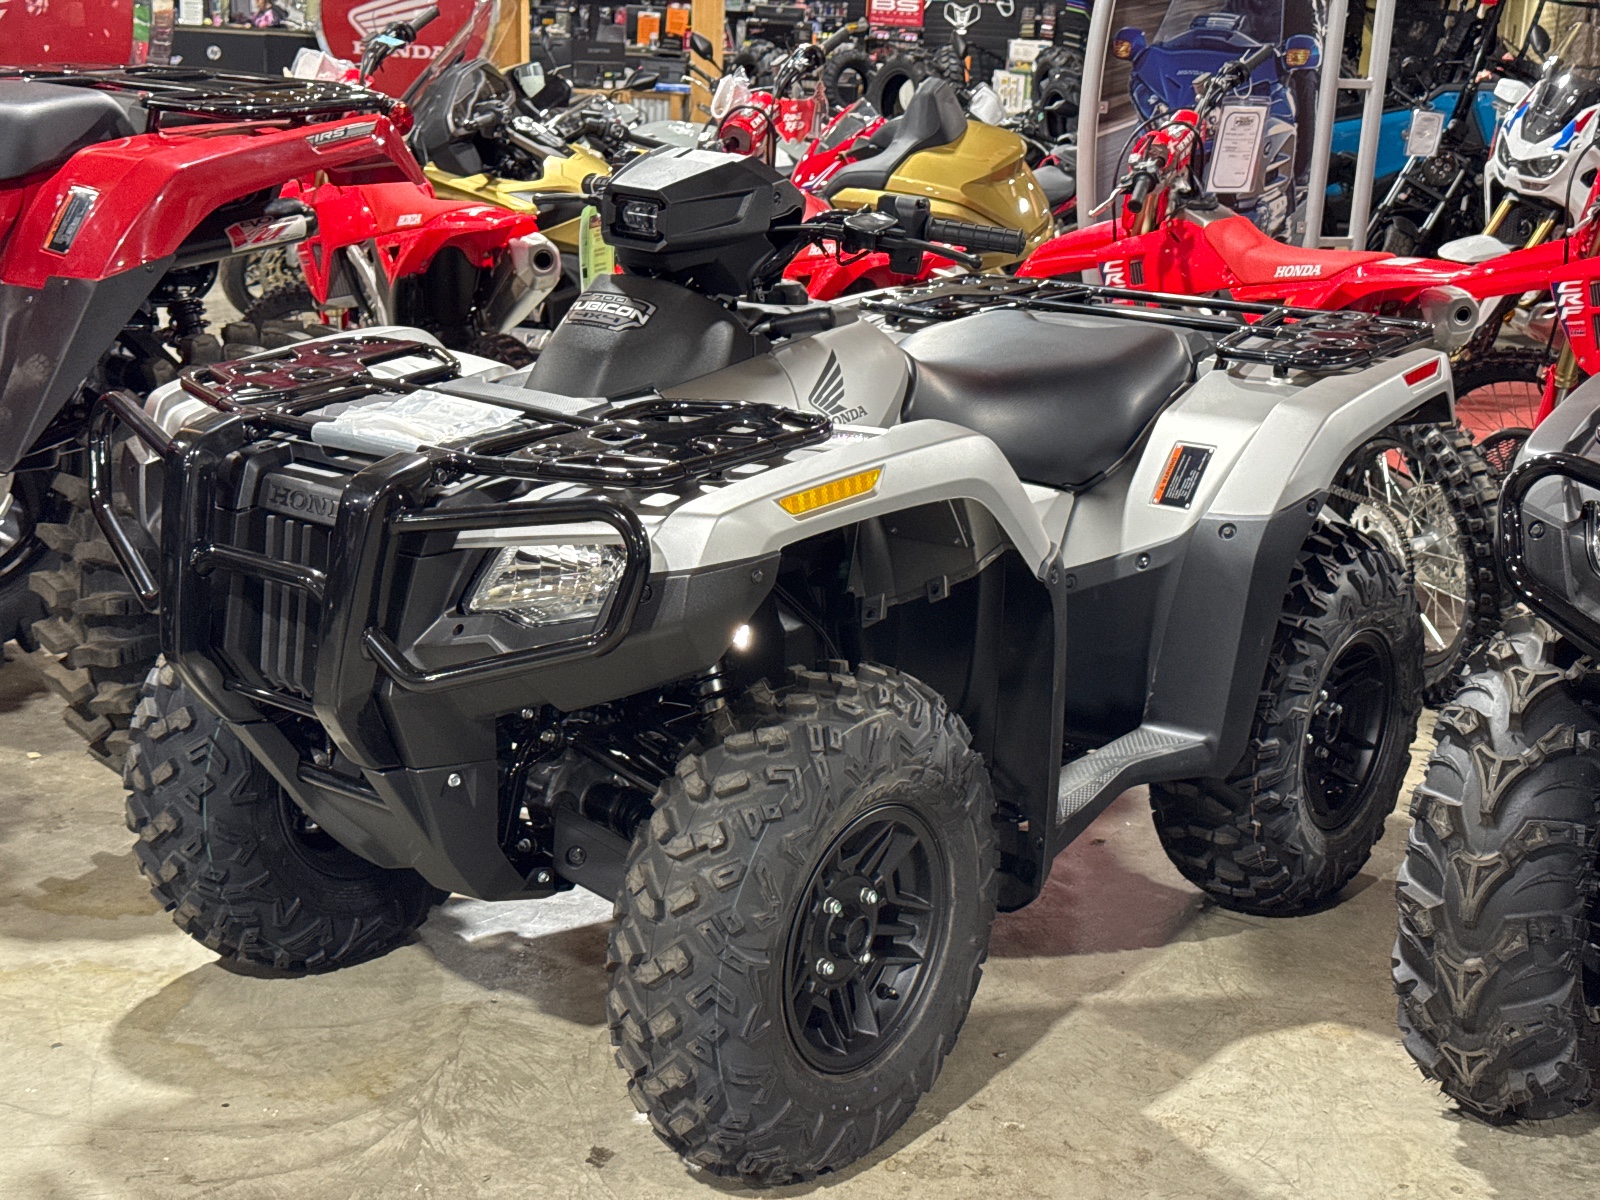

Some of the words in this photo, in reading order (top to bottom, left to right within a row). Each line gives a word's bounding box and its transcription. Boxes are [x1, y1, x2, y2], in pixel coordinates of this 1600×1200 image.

[871, 0, 920, 12] BS
[314, 126, 346, 143] IRS
[1273, 264, 1322, 279] HONDA
[592, 293, 629, 304] 700
[1556, 280, 1586, 321] CRF
[831, 405, 869, 425] ONDA
